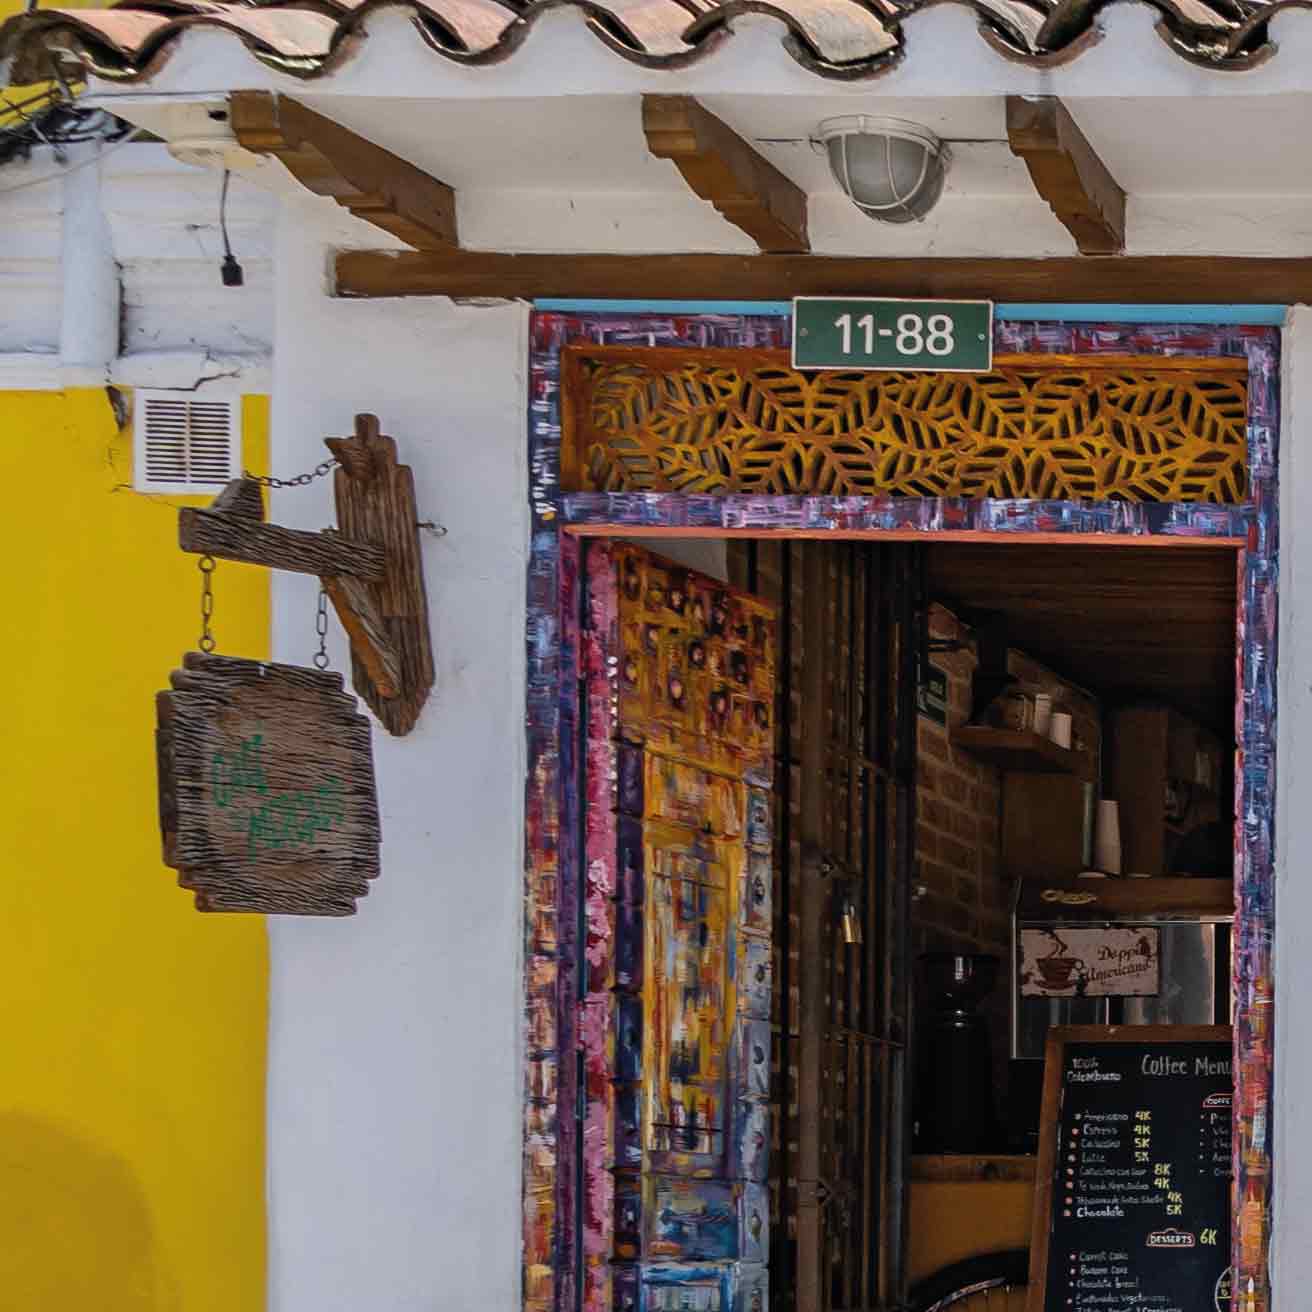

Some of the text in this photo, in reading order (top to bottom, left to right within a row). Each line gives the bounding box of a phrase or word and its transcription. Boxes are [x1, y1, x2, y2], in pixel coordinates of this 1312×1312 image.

[834, 313, 954, 356] 11-88
[1141, 1054, 1187, 1076] Coffee
[1134, 1138, 1150, 1148] 5K
[1134, 1152, 1150, 1162] 5K
[1154, 1164, 1171, 1176] 8K
[1154, 1177, 1170, 1190] 4K
[1077, 1205, 1182, 1217] Chocolate 5K
[1151, 1230, 1217, 1245] DESSERTS 6K
